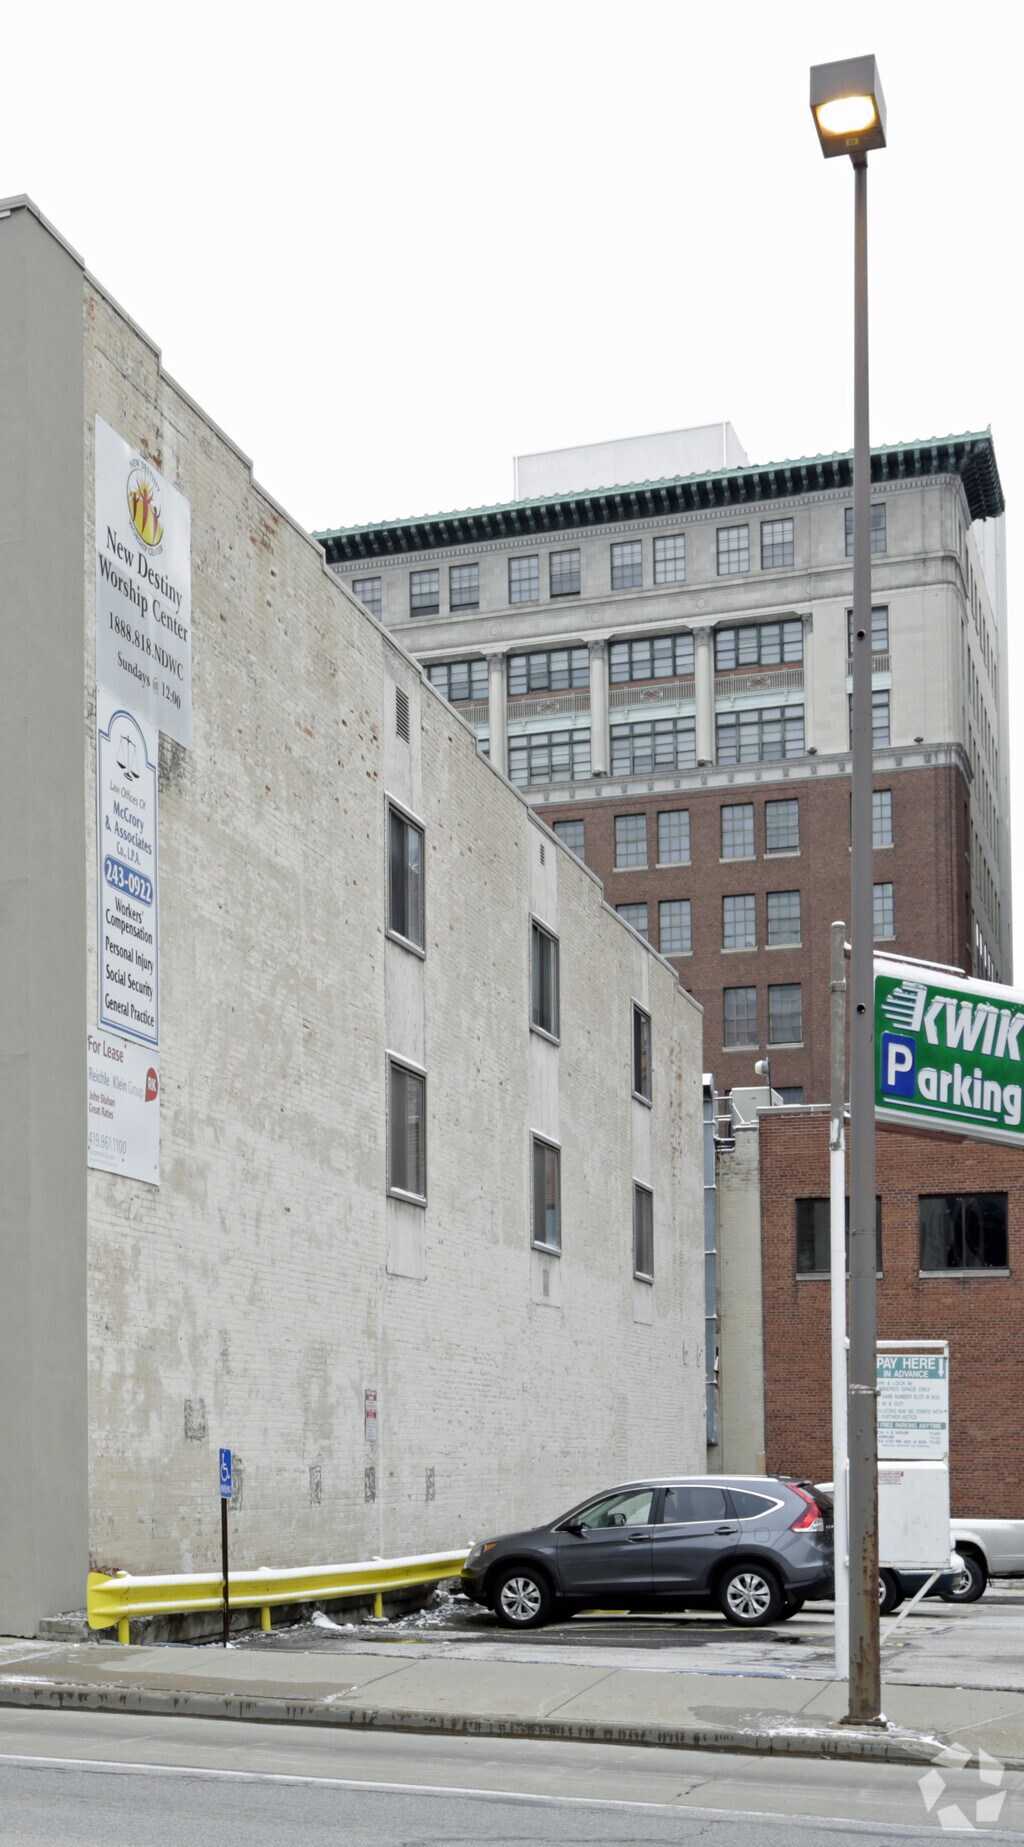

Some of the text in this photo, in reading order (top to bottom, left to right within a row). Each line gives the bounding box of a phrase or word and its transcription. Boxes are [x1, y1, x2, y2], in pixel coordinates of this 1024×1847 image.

[106, 525, 182, 614] New Destiny
[98, 552, 188, 642] Worship Center
[109, 611, 183, 681] 1888.818.NDWC
[117, 651, 150, 688] Sundays
[161, 682, 181, 709] 12:00
[105, 814, 152, 855] & Associates
[113, 800, 145, 834] McCrory
[105, 860, 152, 902] 243-0922
[105, 908, 153, 945] Compensation
[115, 896, 144, 924] Workers'
[105, 936, 154, 976] Personal Injury
[105, 964, 154, 1002] Social Security
[105, 993, 154, 1028] General Practice
[881, 980, 1024, 1062] KWIK
[88, 1034, 124, 1063] For Lease
[113, 1075, 127, 1093] Klein
[887, 1042, 1023, 1126] Parking
[877, 1357, 936, 1370] PAY HERE
[883, 1370, 929, 1378] IN ADVANCE
